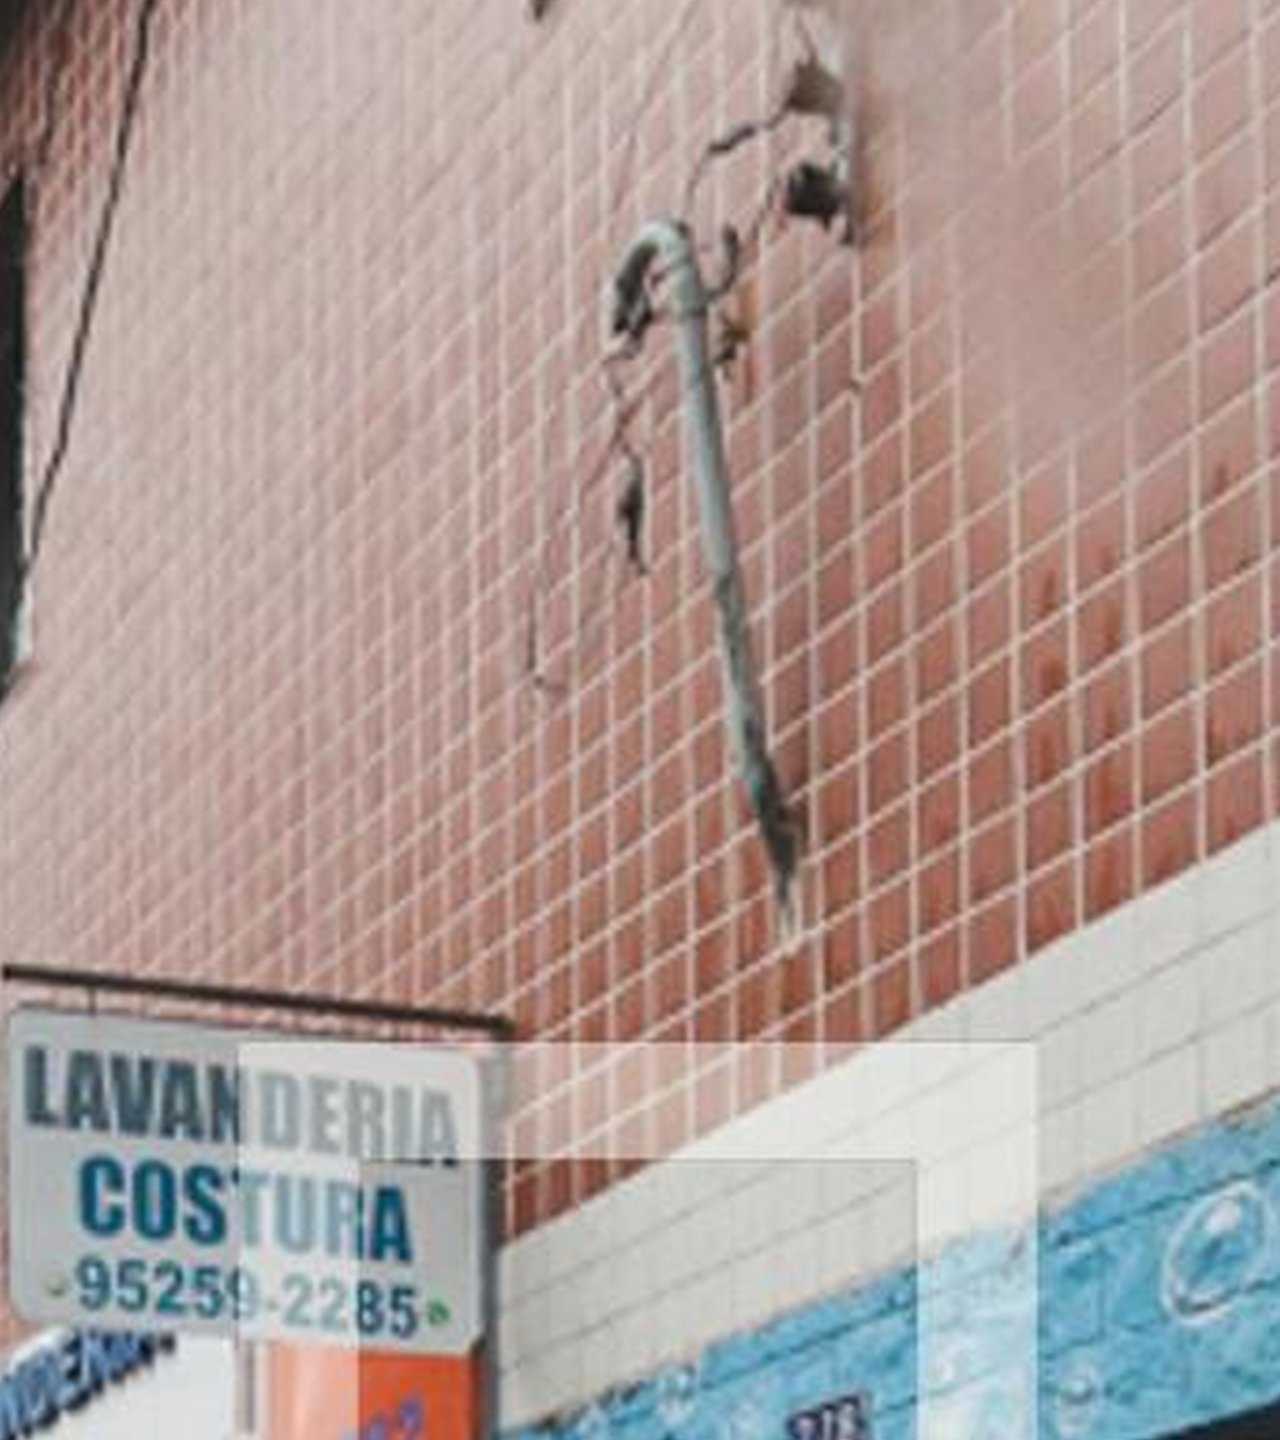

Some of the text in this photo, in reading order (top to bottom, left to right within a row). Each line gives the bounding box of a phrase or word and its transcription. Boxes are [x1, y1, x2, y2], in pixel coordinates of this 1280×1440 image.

[23, 1044, 461, 1168] LAVANDERIA
[78, 1154, 414, 1263] COSTURA
[75, 1255, 420, 1338] 95259-2285
